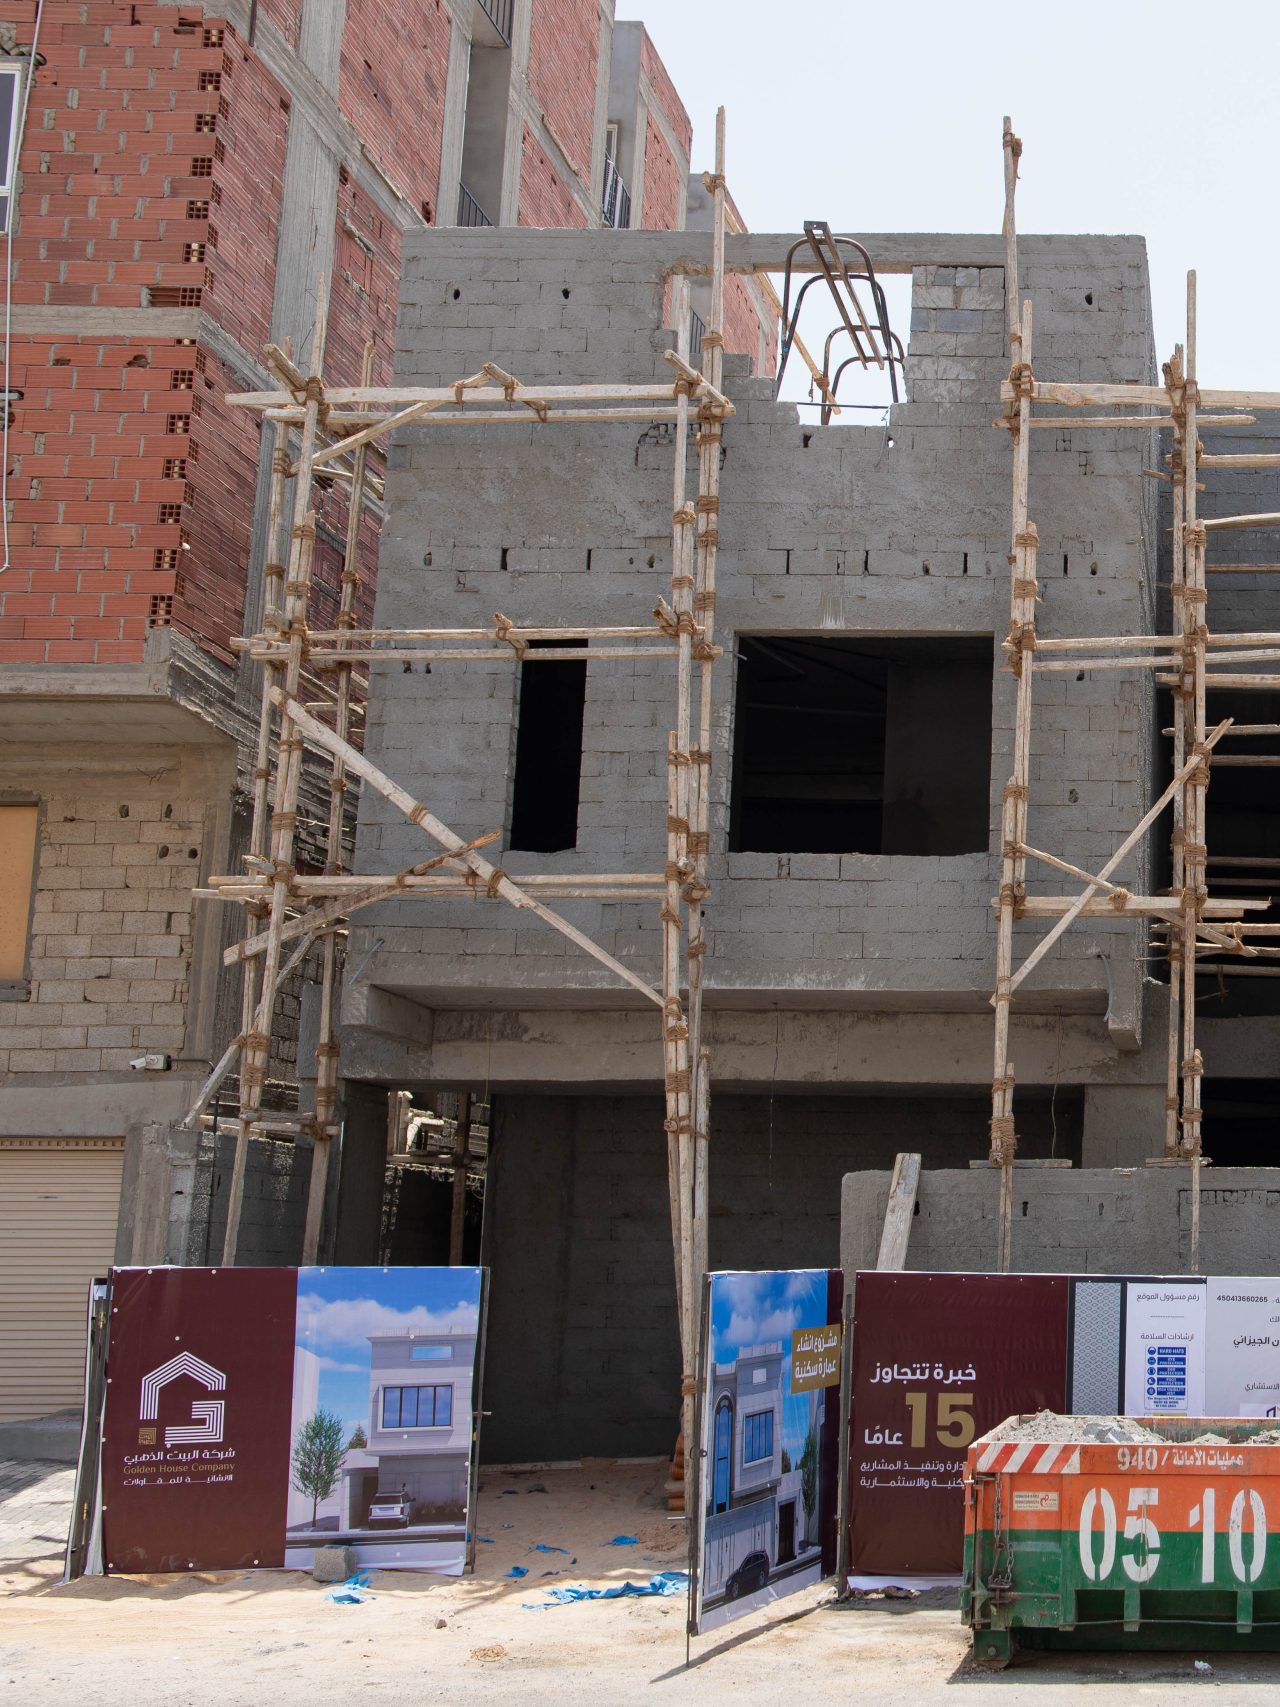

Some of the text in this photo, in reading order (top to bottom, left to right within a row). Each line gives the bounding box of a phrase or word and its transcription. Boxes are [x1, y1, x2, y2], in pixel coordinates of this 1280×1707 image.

[1233, 1335, 1270, 1348] الجيزاني
[795, 1357, 837, 1383] عمارة سكنية
[869, 1362, 976, 1385] خبرة تتجاوز
[905, 1392, 976, 1448] 15
[124, 1448, 236, 1465] شركة البيت الذهبي
[860, 1459, 902, 1472] المشاريع
[1117, 1447, 1159, 1471] 940
[1207, 1450, 1243, 1470] عمليات
[123, 1463, 235, 1475] Golden House Company
[1079, 1487, 1161, 1583] 05
[1189, 1487, 1267, 1583] 10
